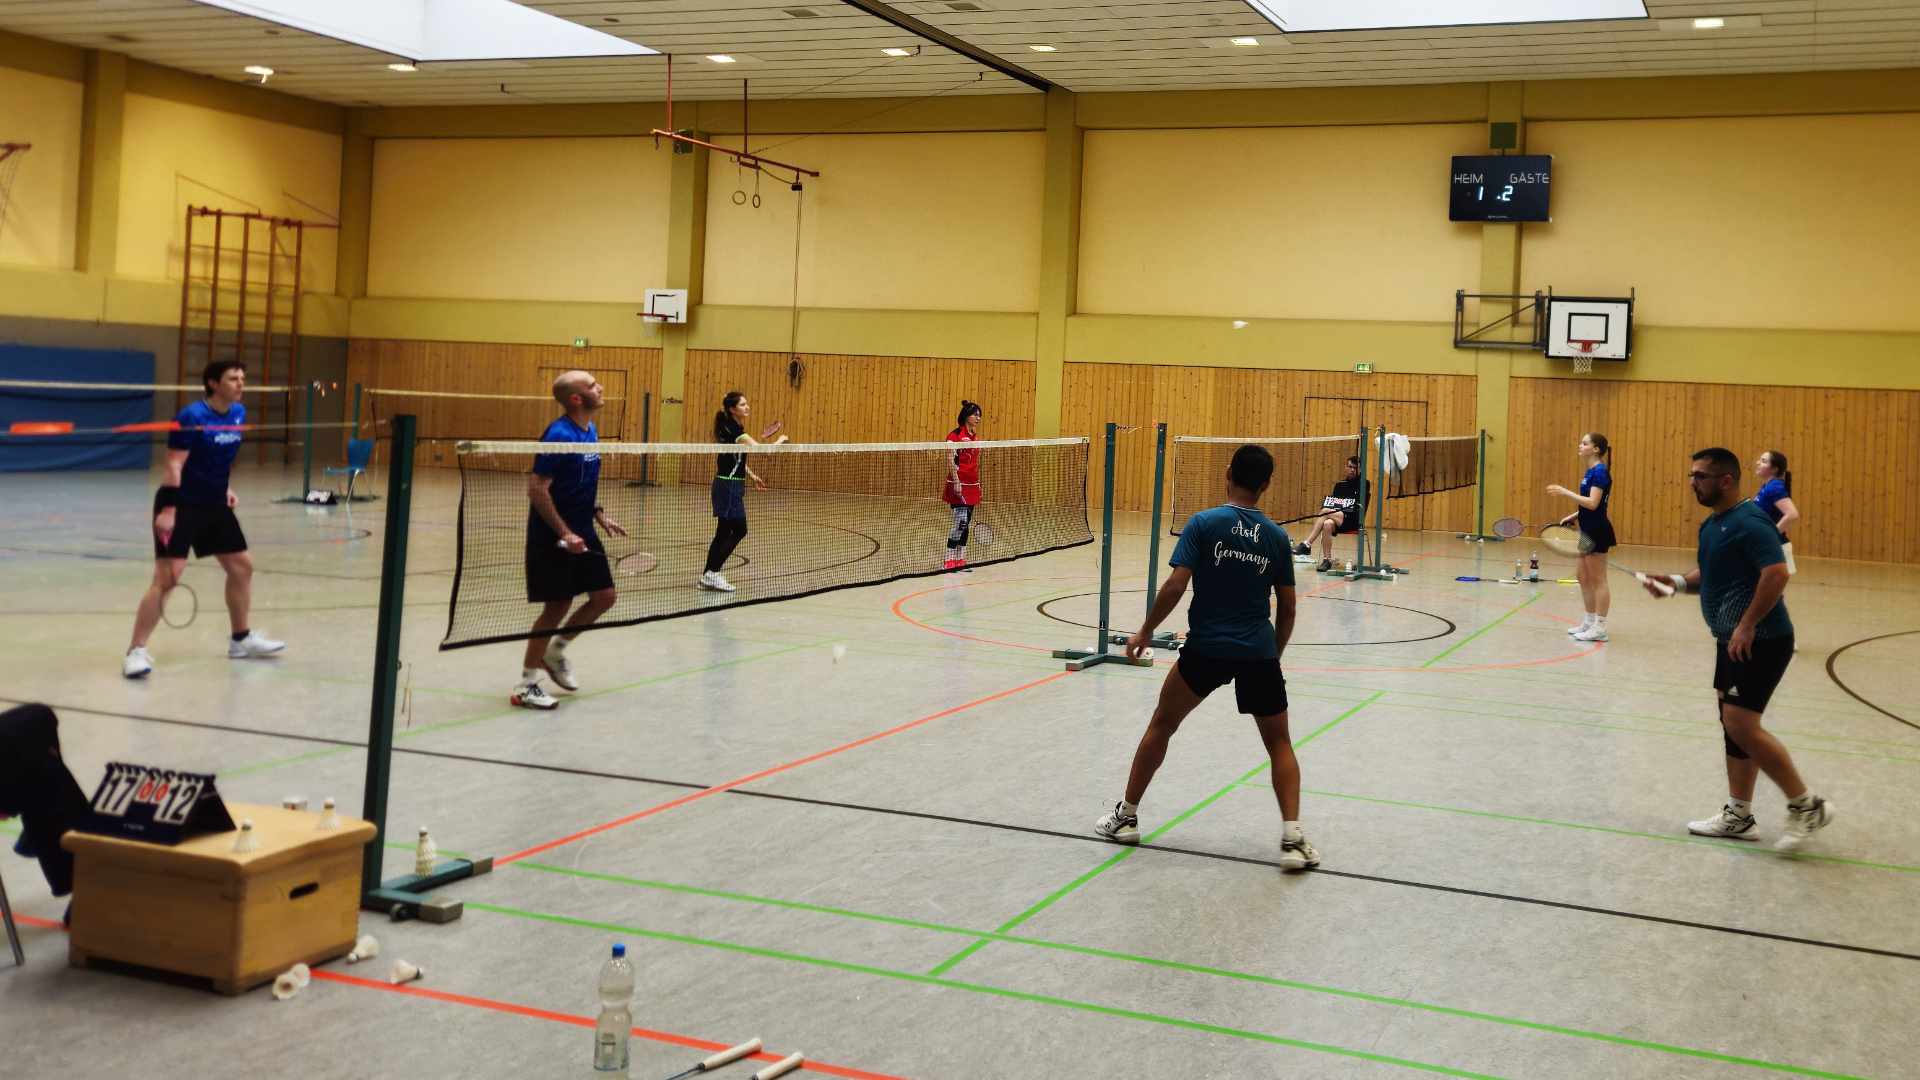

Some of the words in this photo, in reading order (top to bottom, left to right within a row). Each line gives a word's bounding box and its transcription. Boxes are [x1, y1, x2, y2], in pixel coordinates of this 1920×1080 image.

[1454, 173, 1484, 184] HEIM
[1478, 186, 1484, 201] 1
[1231, 520, 1261, 543] Asif
[1214, 541, 1271, 574] Germany
[102, 775, 138, 812] 17
[161, 783, 198, 821] 12
